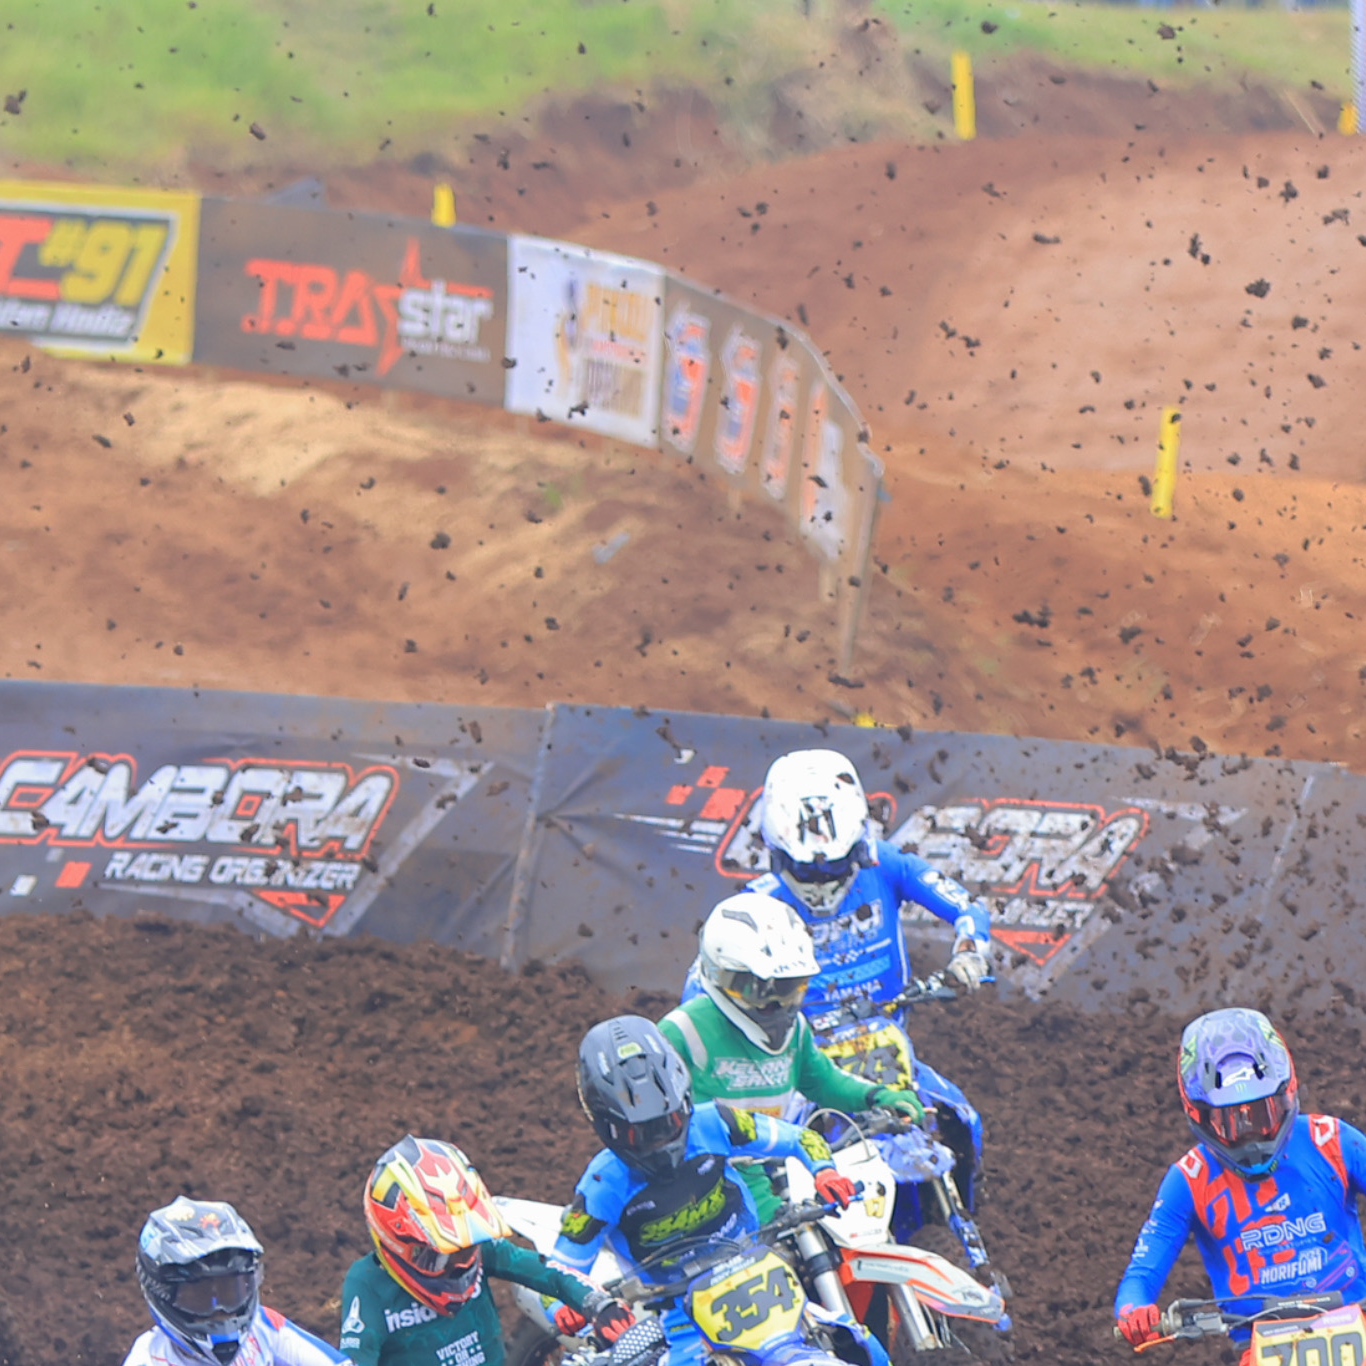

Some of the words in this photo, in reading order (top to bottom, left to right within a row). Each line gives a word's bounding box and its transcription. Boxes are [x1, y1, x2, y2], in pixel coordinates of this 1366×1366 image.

[104, 850, 206, 883] RACING
[1240, 1211, 1328, 1252] RDNG
[711, 1265, 797, 1343] 354
[436, 1330, 479, 1361] VICTORY
[455, 1352, 470, 1365] OR
